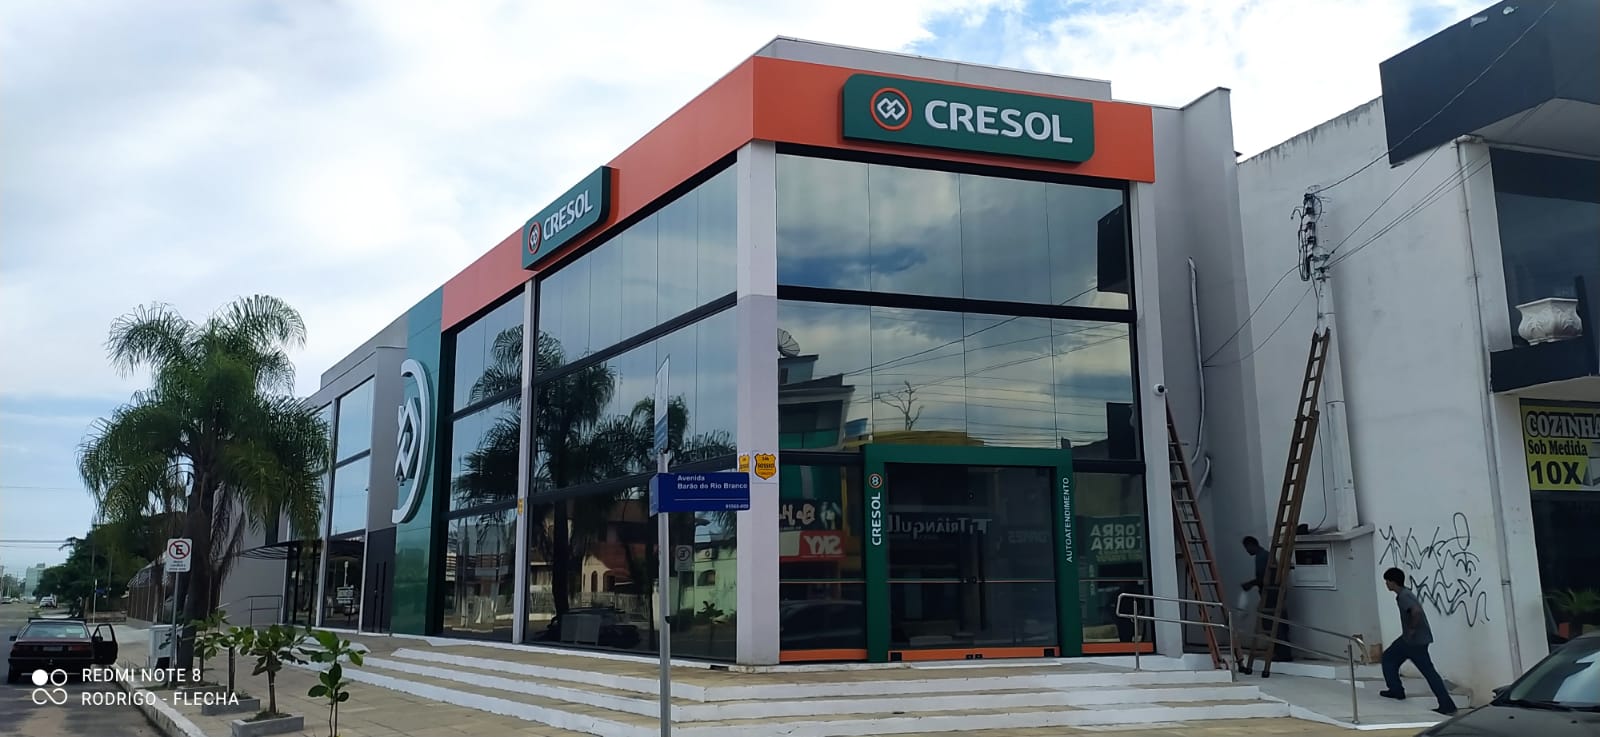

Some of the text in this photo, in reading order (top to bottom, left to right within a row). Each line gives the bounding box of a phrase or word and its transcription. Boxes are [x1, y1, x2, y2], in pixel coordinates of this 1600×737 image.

[925, 99, 1073, 144] CRESOL
[543, 189, 594, 241] CRESOL
[1528, 439, 1588, 456] Sob Medida
[1531, 460, 1582, 485] 10X
[871, 491, 882, 546] CRESOL
[1062, 477, 1073, 563] AUTOATENDIMENTO
